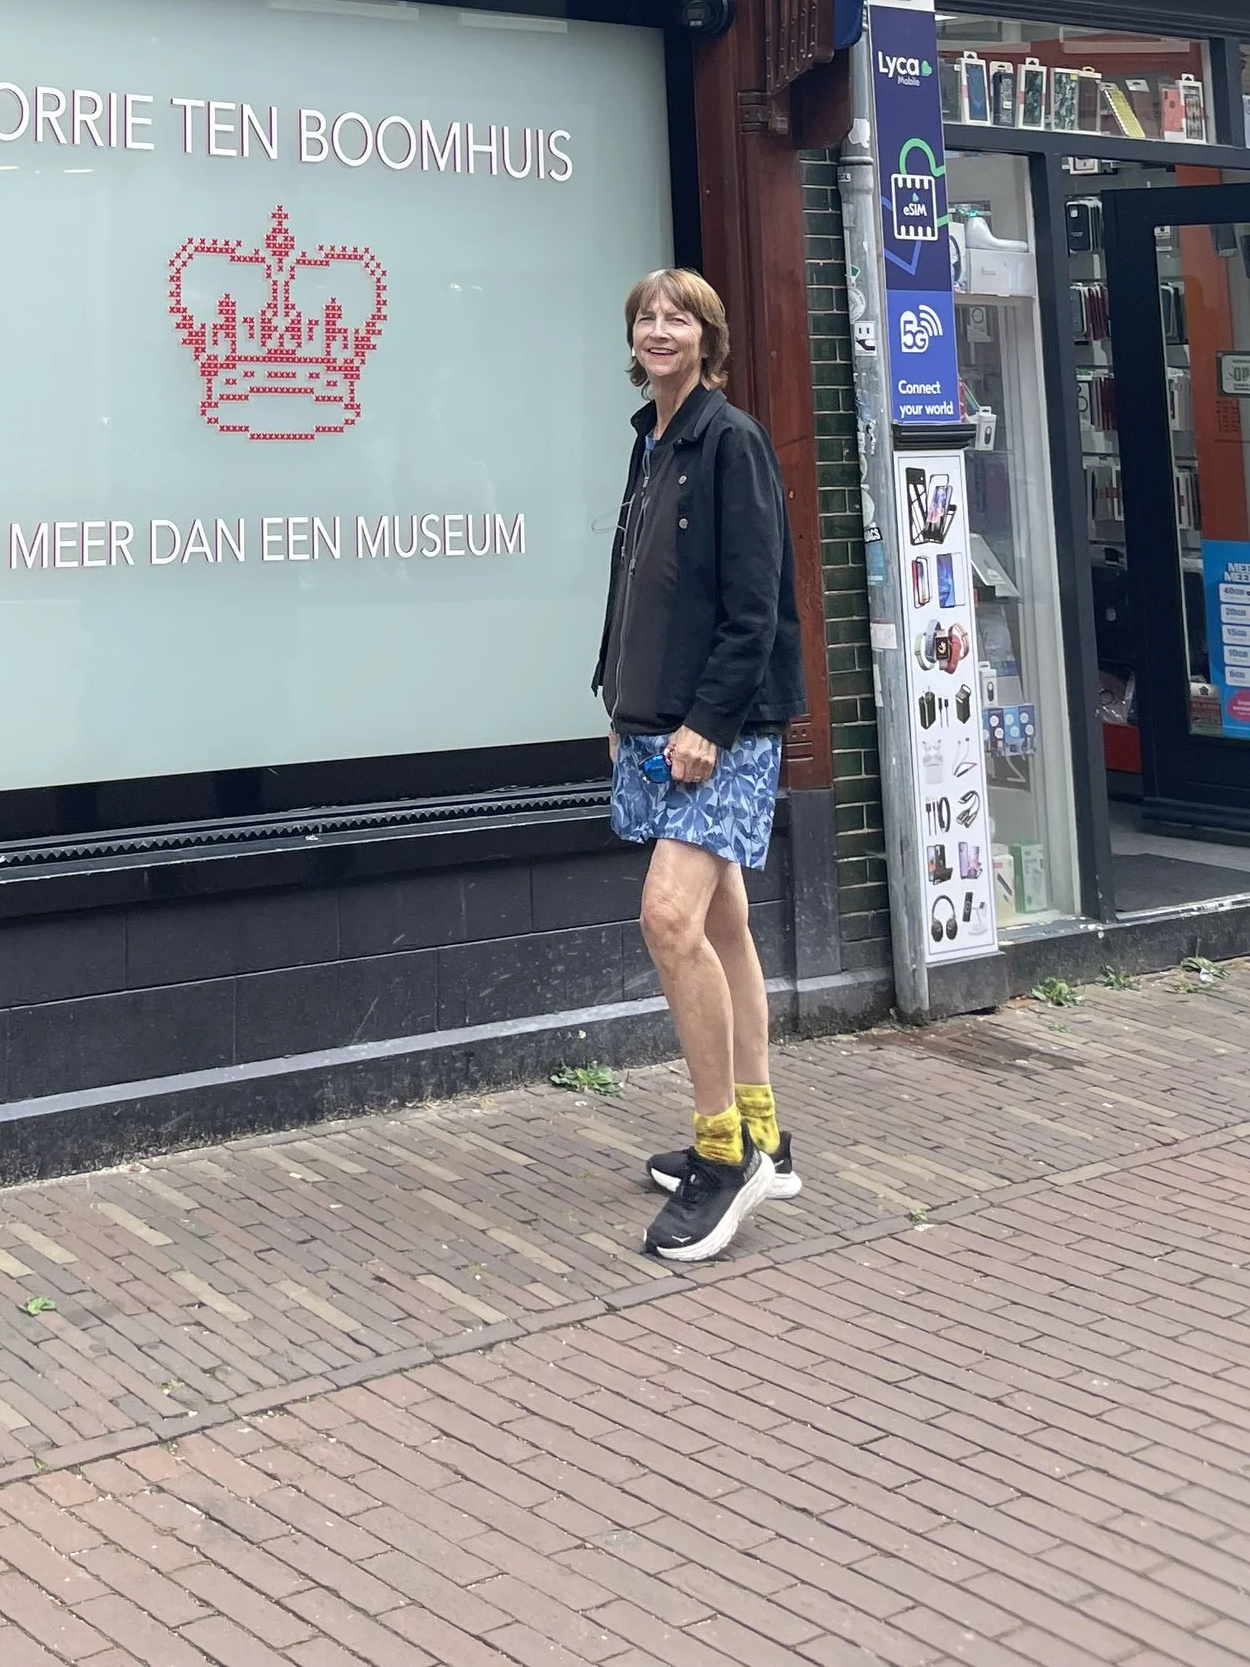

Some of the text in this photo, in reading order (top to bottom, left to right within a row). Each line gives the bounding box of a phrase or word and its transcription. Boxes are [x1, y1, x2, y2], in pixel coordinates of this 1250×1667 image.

[878, 50, 920, 78] Lyca
[897, 75, 921, 87] Mobile
[170, 97, 279, 161] TEN
[299, 107, 574, 182] BOOMHUIS
[902, 202, 928, 217] eSIM
[902, 319, 928, 351] 5G
[898, 378, 942, 396] Connect
[899, 400, 954, 419] your world
[8, 511, 527, 571] MEER DAN EEN MUSEUM
